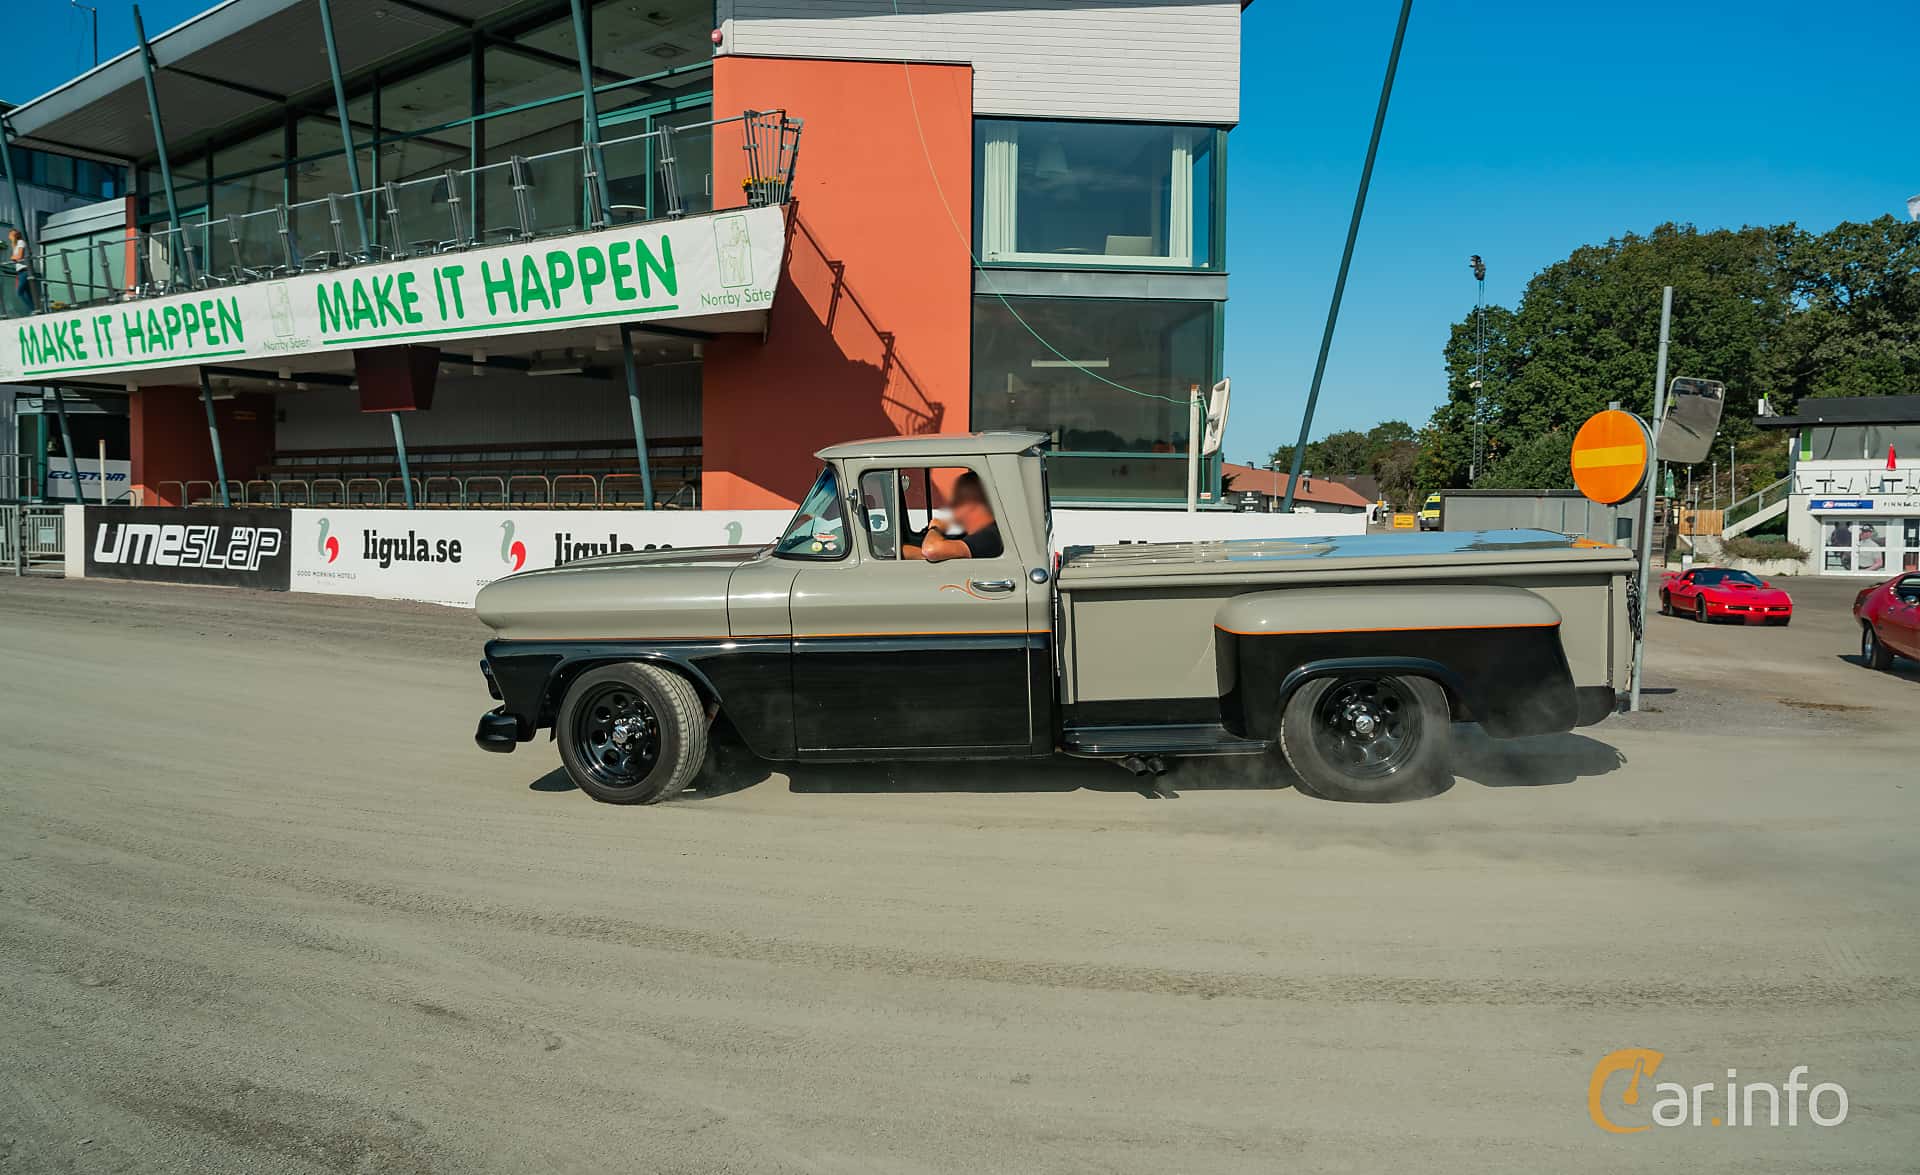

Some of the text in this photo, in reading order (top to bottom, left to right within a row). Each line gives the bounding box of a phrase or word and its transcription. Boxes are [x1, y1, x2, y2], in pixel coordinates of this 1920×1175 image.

[317, 234, 679, 333] MAKE IT HAPPEN
[701, 290, 741, 307] Norrby
[19, 296, 244, 366] MAKE IT HAPPEN
[363, 529, 462, 569] ligula.se
